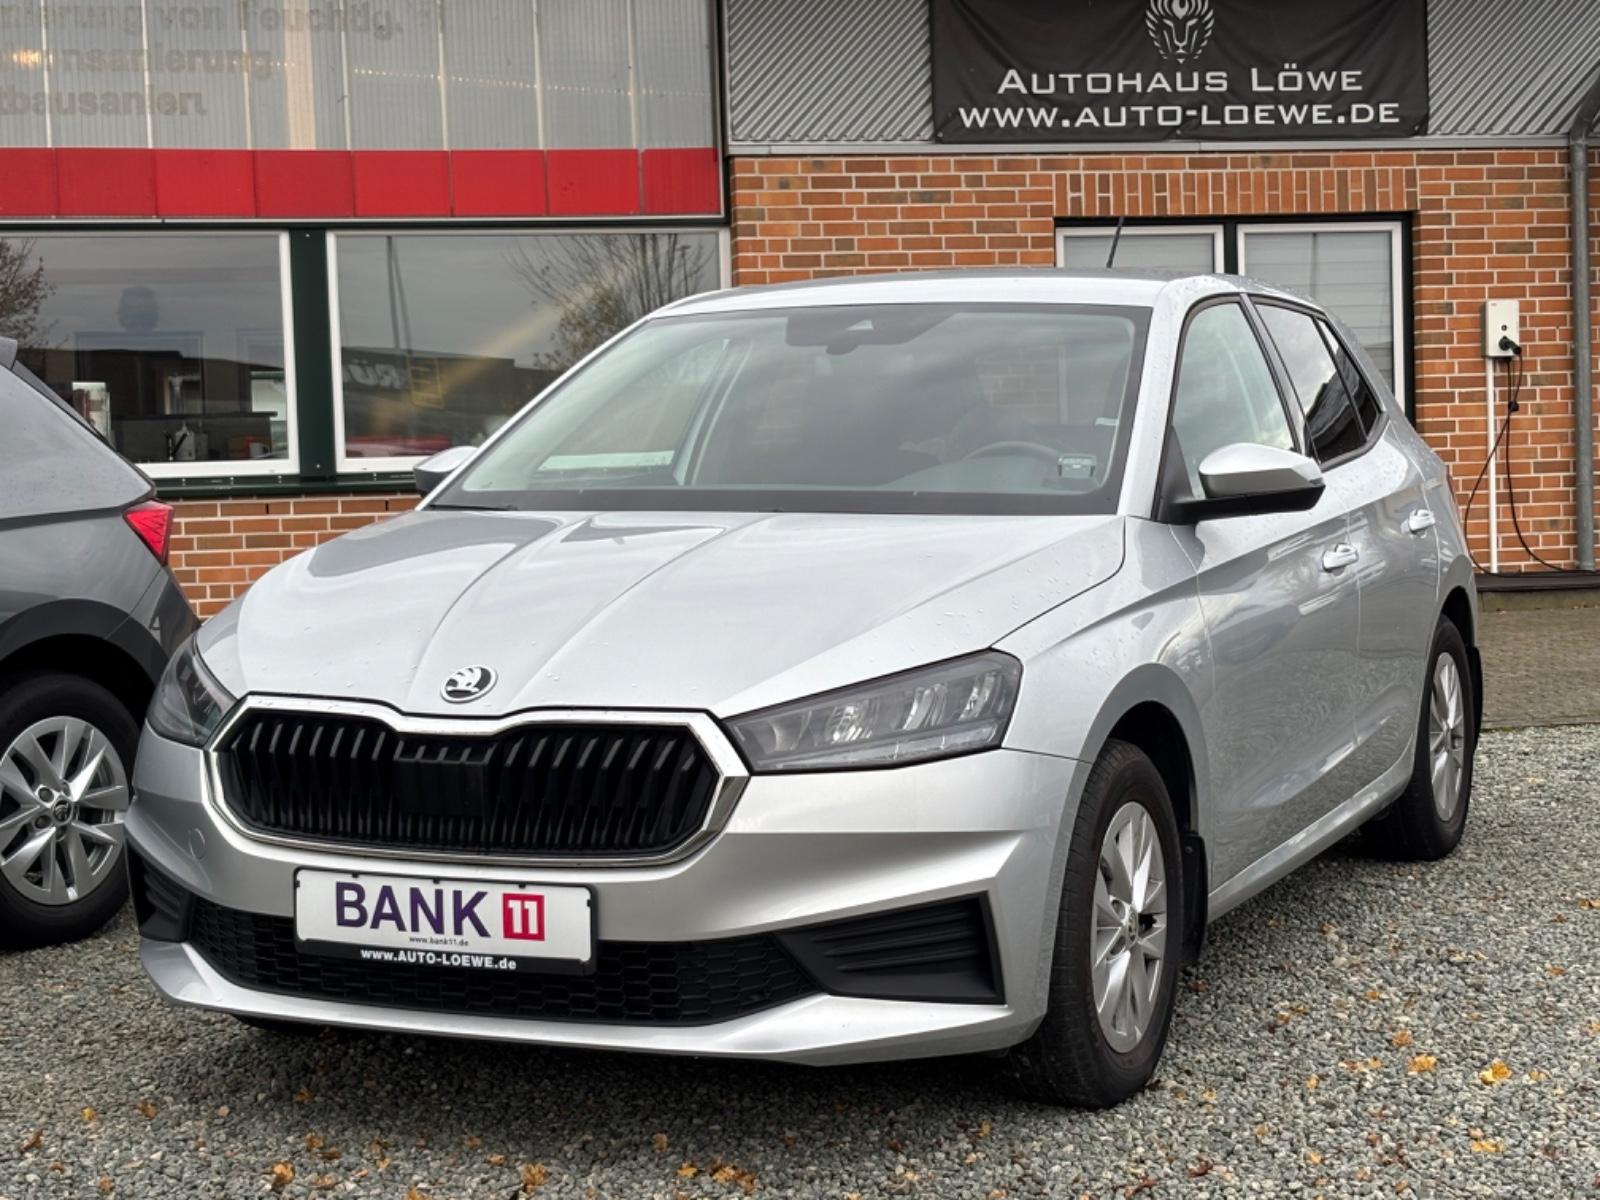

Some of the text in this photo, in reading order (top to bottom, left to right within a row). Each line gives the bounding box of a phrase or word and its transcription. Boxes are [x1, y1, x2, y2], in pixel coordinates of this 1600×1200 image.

[154, 7, 222, 30] von
[997, 63, 1363, 95] AUTOHAUS LÖWE
[335, 881, 539, 938] BANK 11
[409, 936, 469, 946] www.bank11.de
[360, 949, 517, 970] www.AUTO-LOEWE.de
